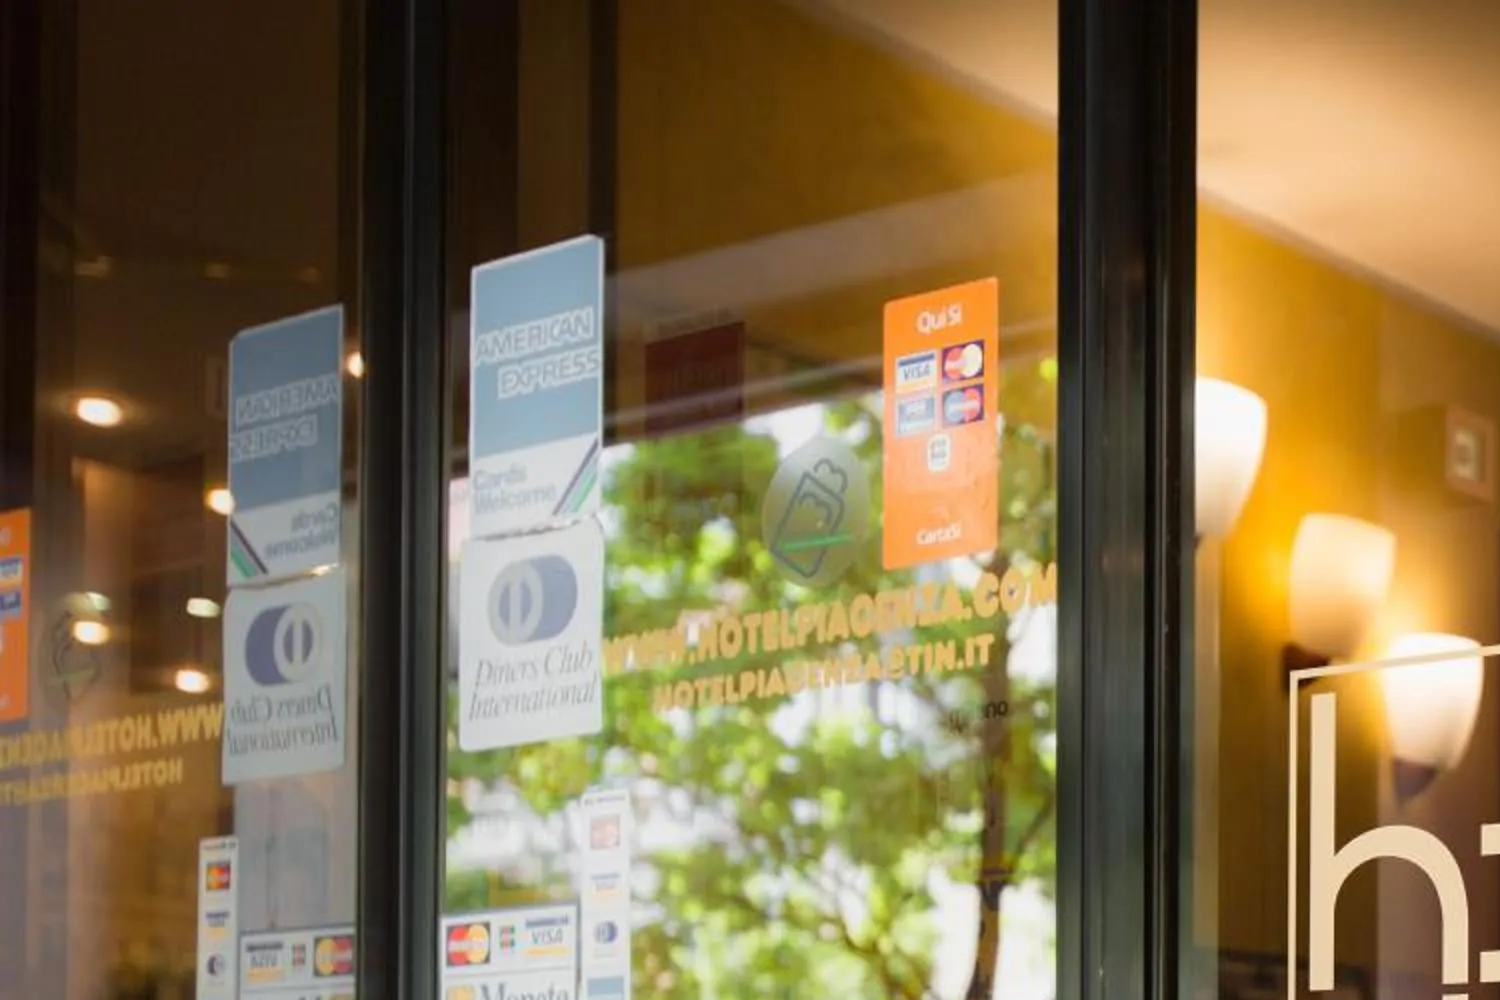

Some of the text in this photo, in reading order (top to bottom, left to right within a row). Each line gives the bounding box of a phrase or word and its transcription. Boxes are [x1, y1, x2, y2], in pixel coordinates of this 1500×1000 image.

[474, 306, 594, 366] AMERICAN
[498, 345, 600, 398] EXPRESS
[903, 362, 931, 381] VISA
[475, 639, 594, 688] Diners Club
[469, 672, 597, 722] International
[532, 927, 563, 945] VISA
